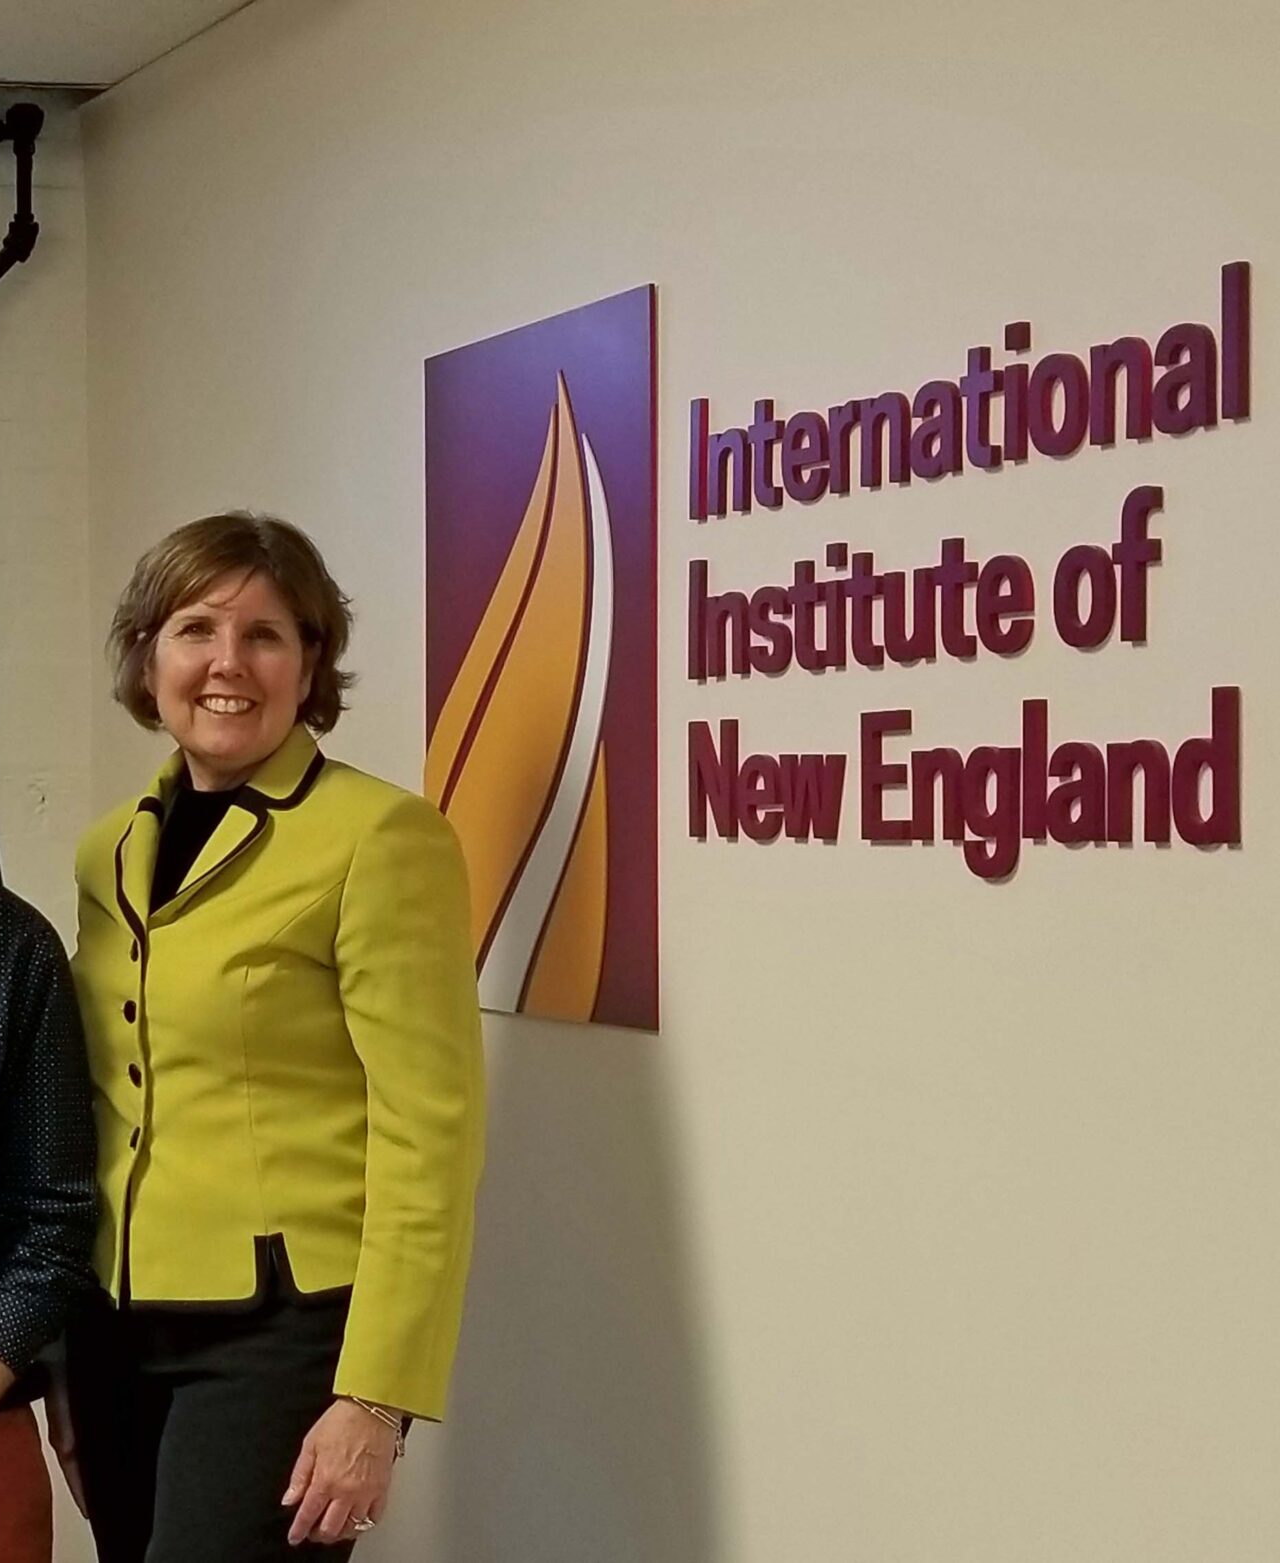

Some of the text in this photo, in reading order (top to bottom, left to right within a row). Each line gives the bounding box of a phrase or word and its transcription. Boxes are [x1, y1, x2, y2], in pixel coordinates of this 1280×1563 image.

[689, 261, 1250, 521] International
[688, 485, 1163, 681] Institute of
[688, 686, 1241, 879] New England
